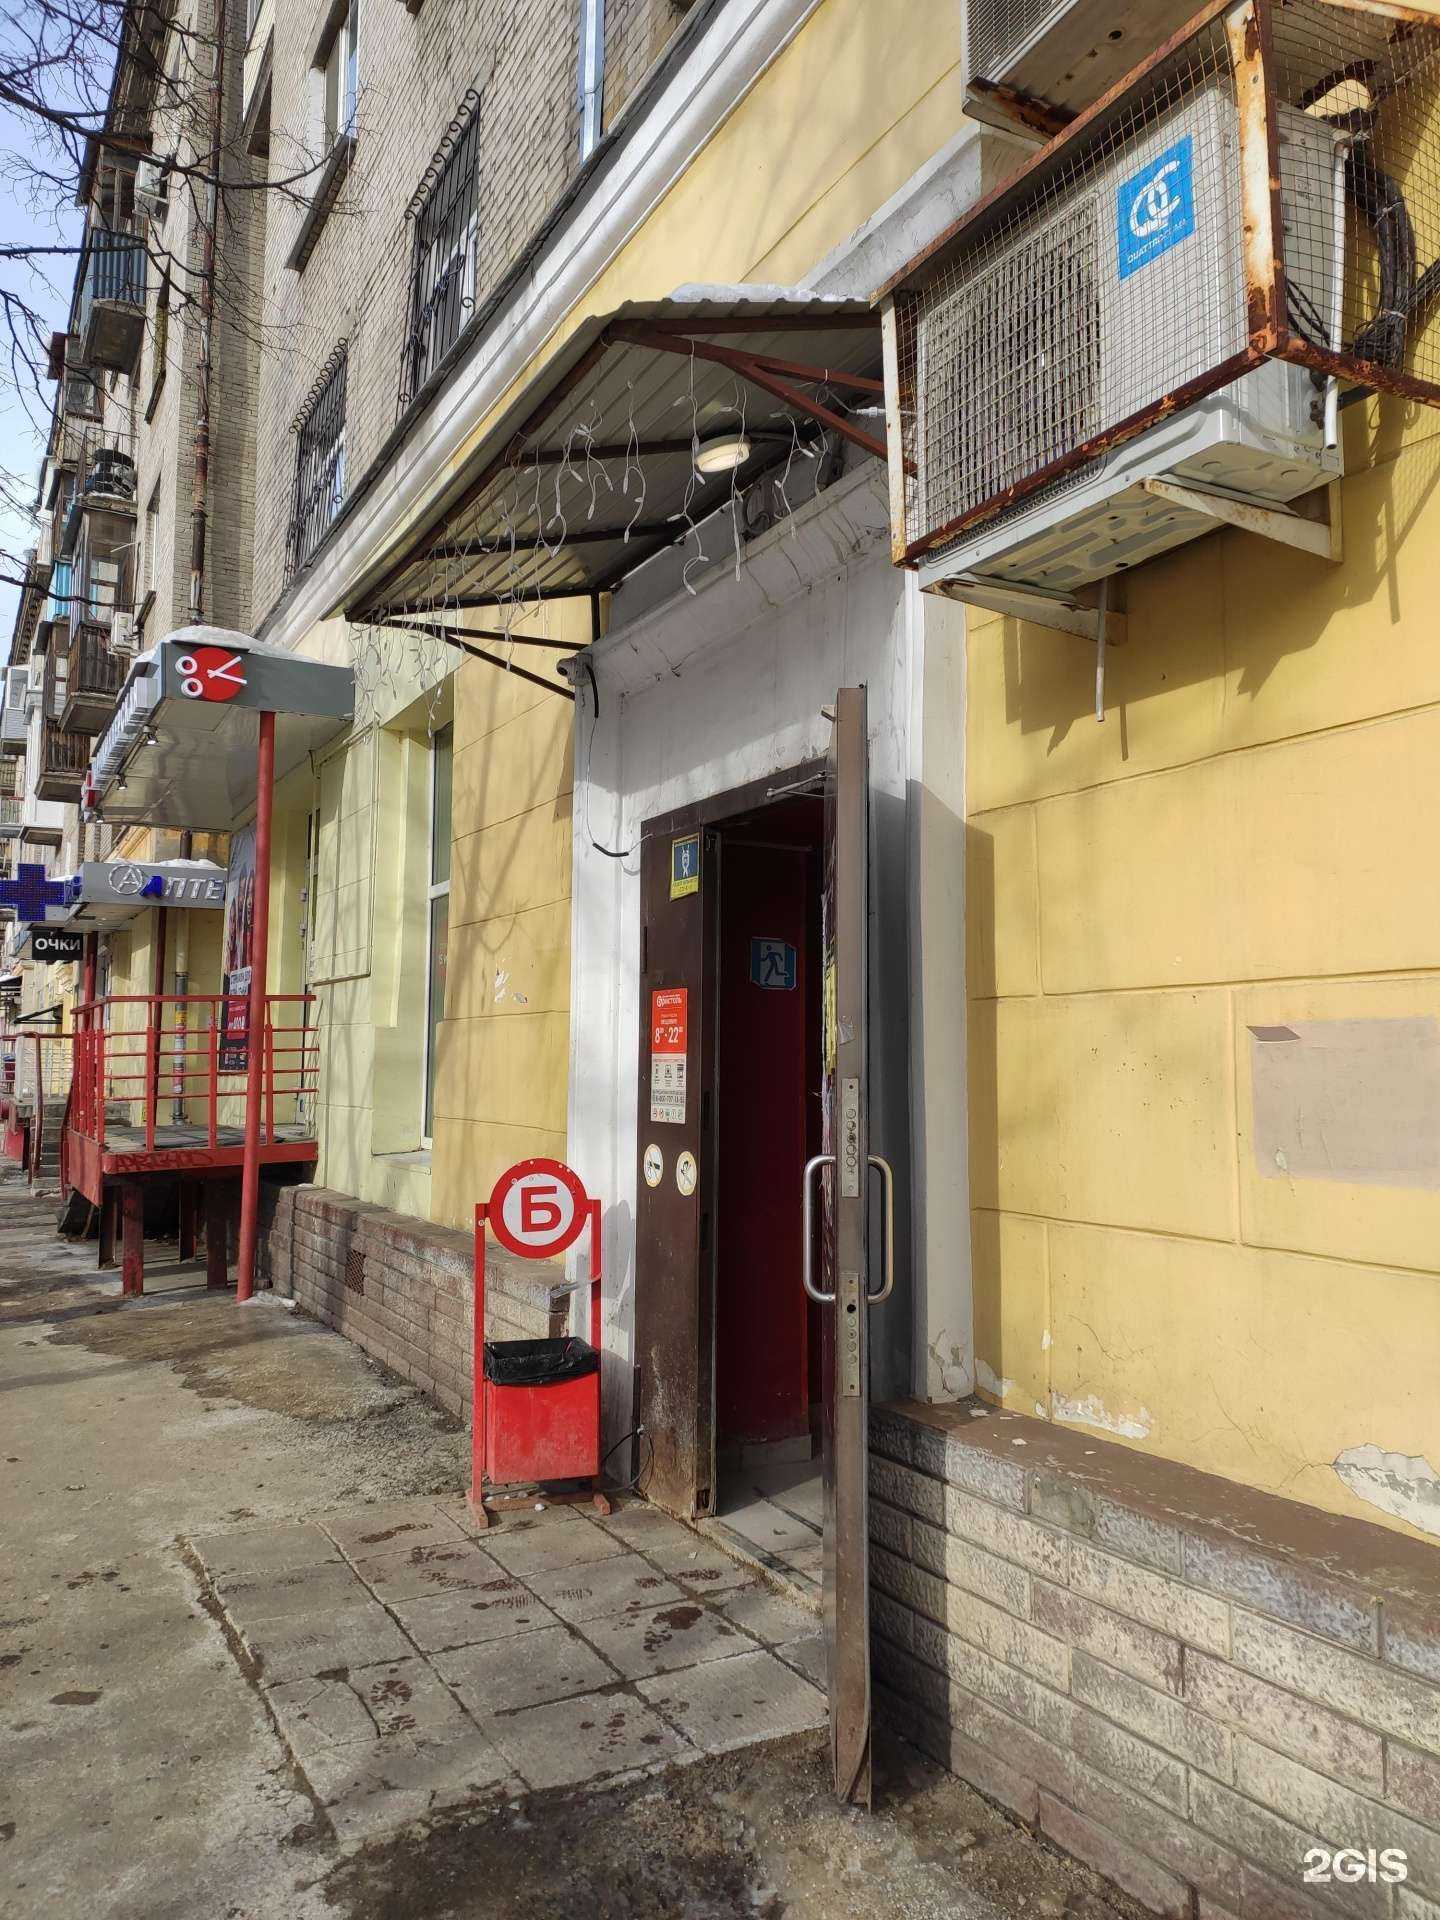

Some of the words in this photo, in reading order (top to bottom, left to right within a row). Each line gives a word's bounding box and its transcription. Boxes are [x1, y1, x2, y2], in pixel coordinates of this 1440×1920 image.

[139, 875, 225, 900] АПТЕ
[34, 937, 81, 952] ОЧКИ
[520, 1185, 562, 1233] Б
